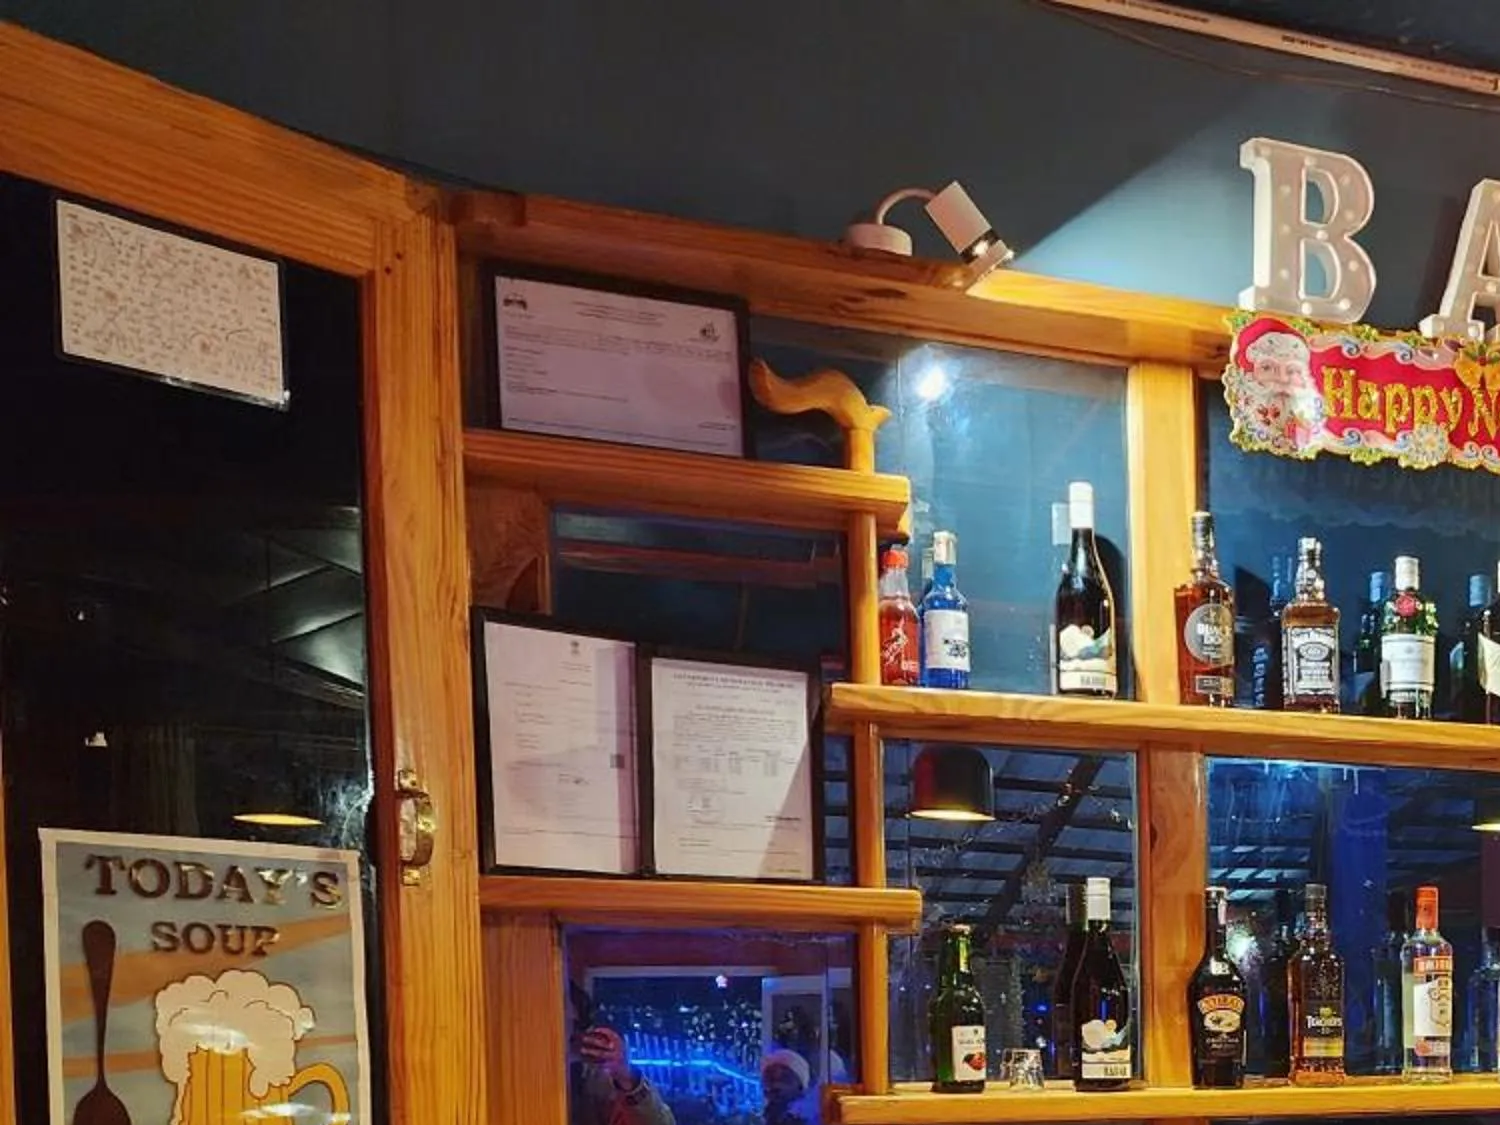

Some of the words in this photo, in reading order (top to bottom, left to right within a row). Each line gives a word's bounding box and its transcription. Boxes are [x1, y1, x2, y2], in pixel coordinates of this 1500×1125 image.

[1322, 365, 1464, 434] Happy
[85, 854, 343, 909] TODAY'S
[151, 921, 280, 957] SOUP
